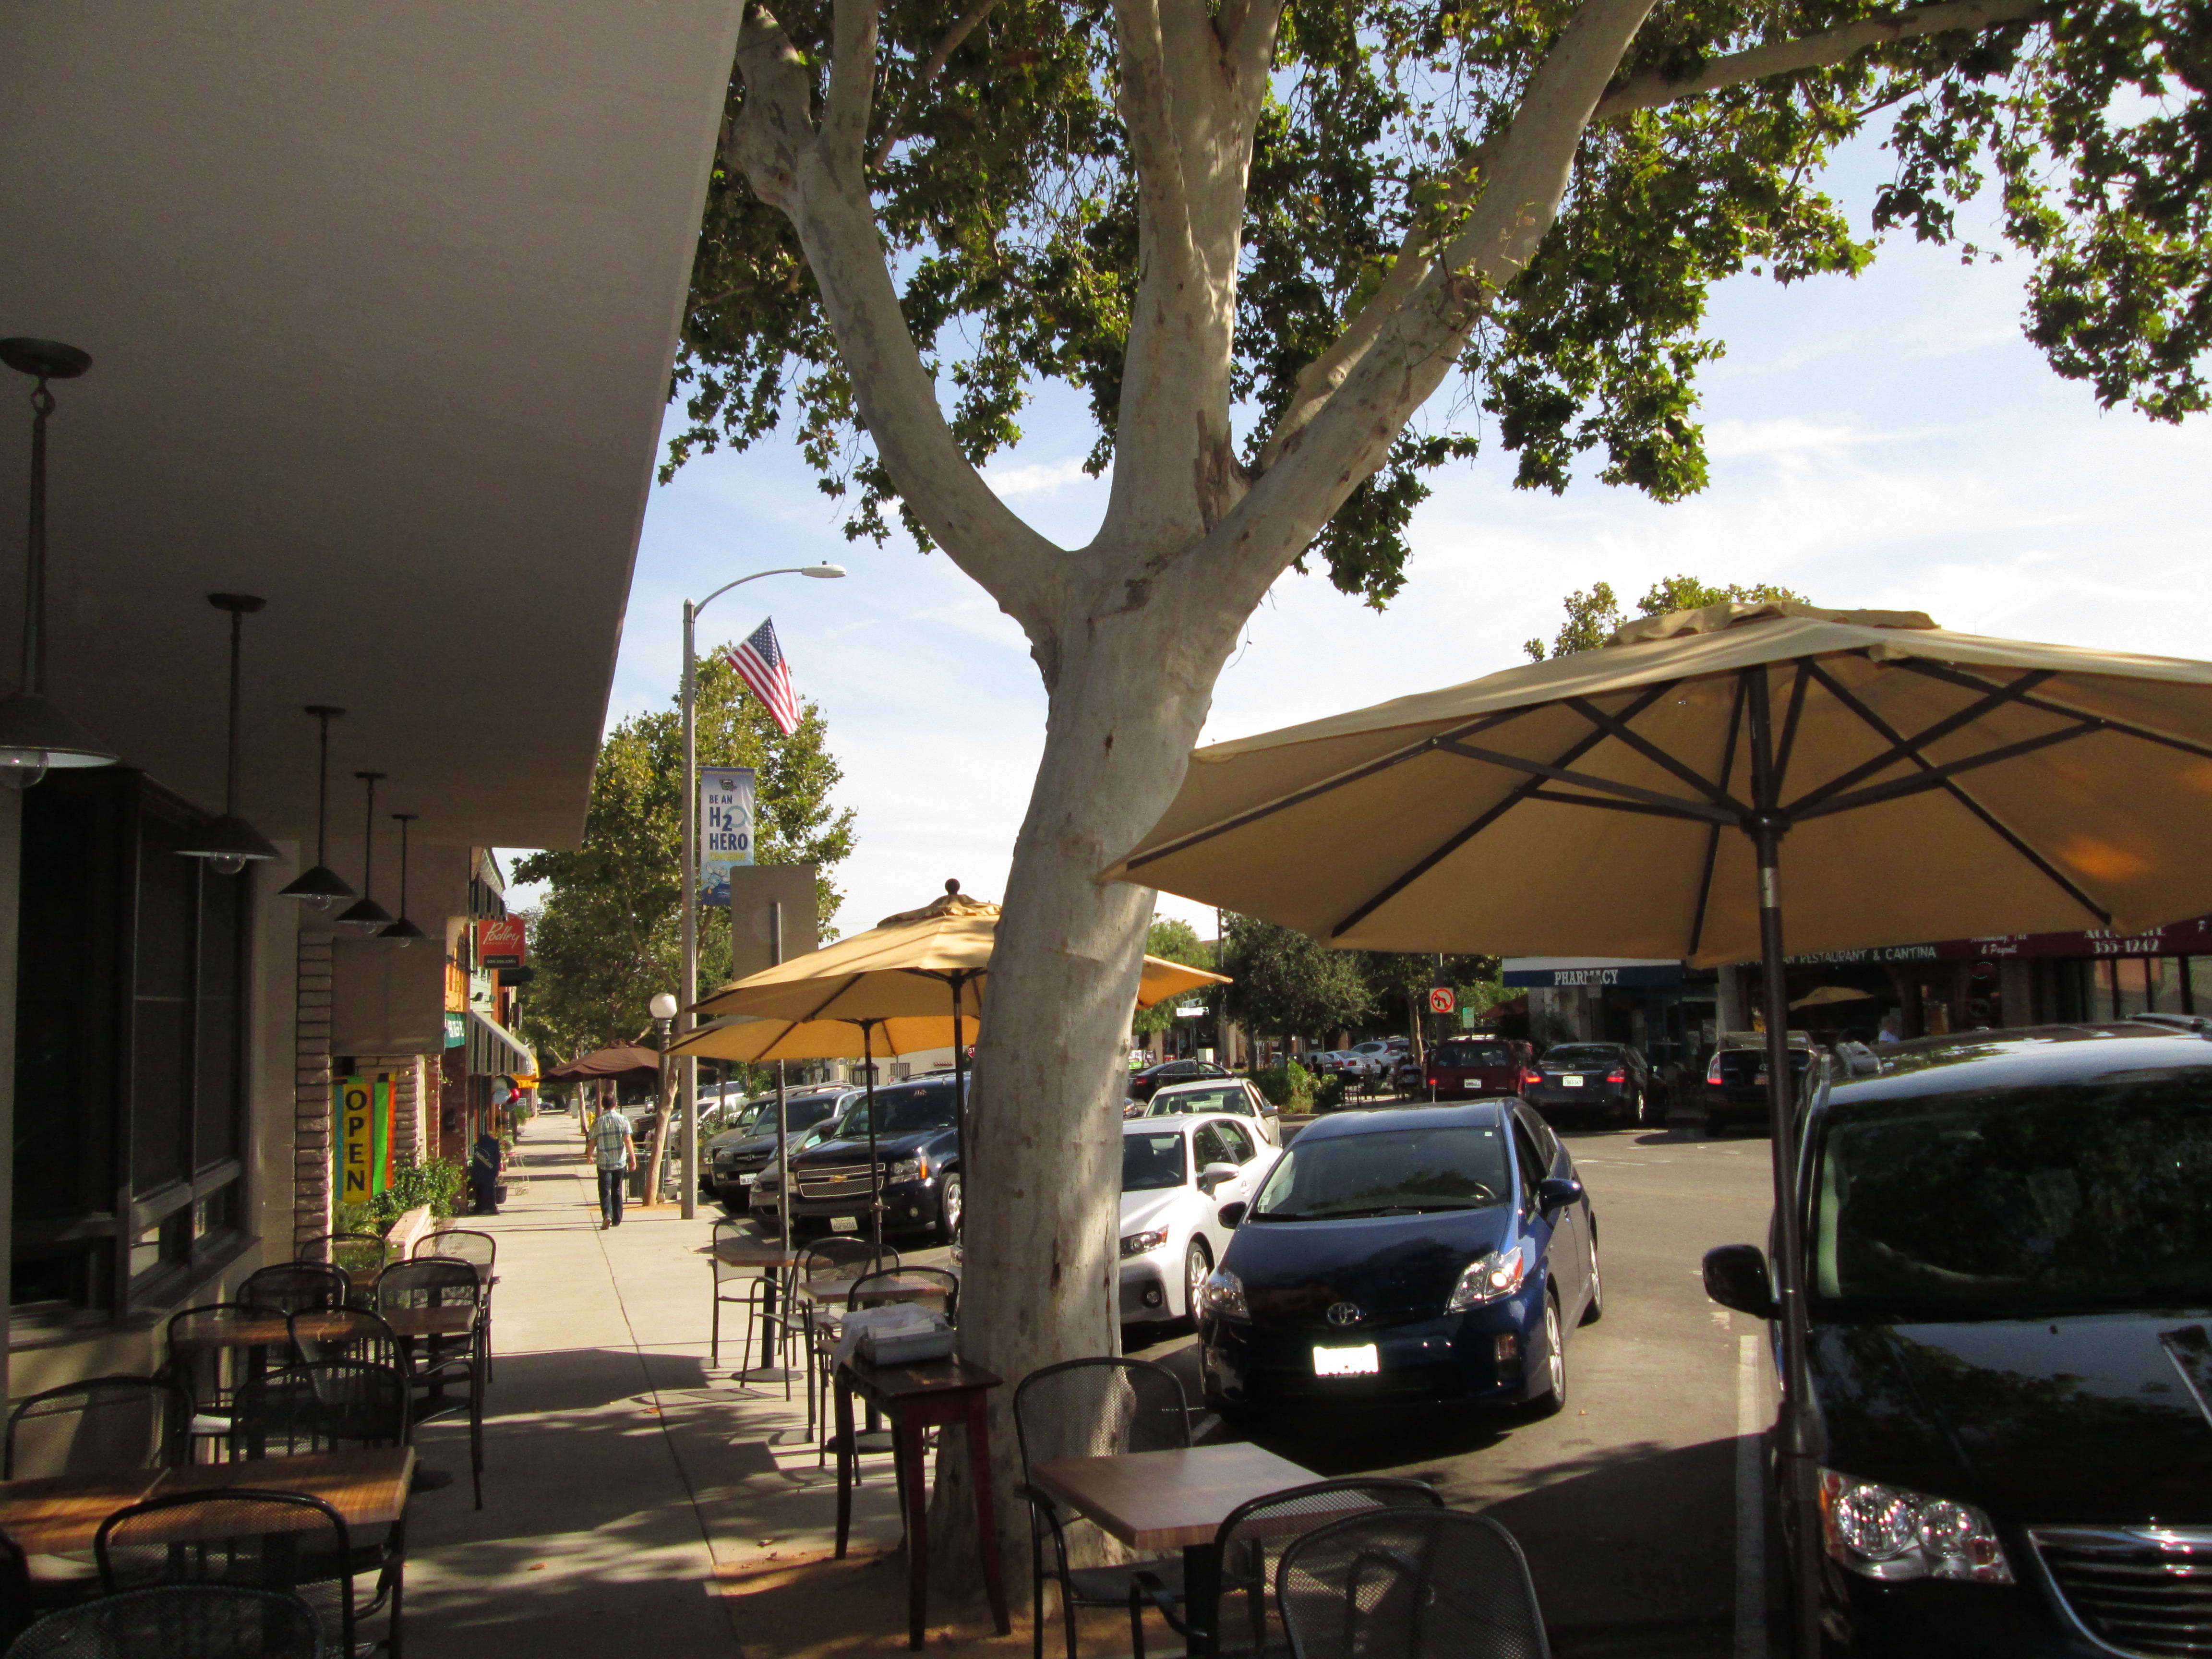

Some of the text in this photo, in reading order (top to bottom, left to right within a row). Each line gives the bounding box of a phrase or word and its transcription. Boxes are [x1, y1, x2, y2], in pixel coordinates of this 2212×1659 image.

[709, 794, 733, 804] BE AN
[709, 833, 748, 851] HERO
[1800, 949, 1867, 963] RESTAURANT
[1873, 949, 1881, 961] &
[1886, 946, 1936, 960] CANTINA
[2092, 938, 2160, 954] 355-1242
[346, 1090, 367, 1191] OPEN
